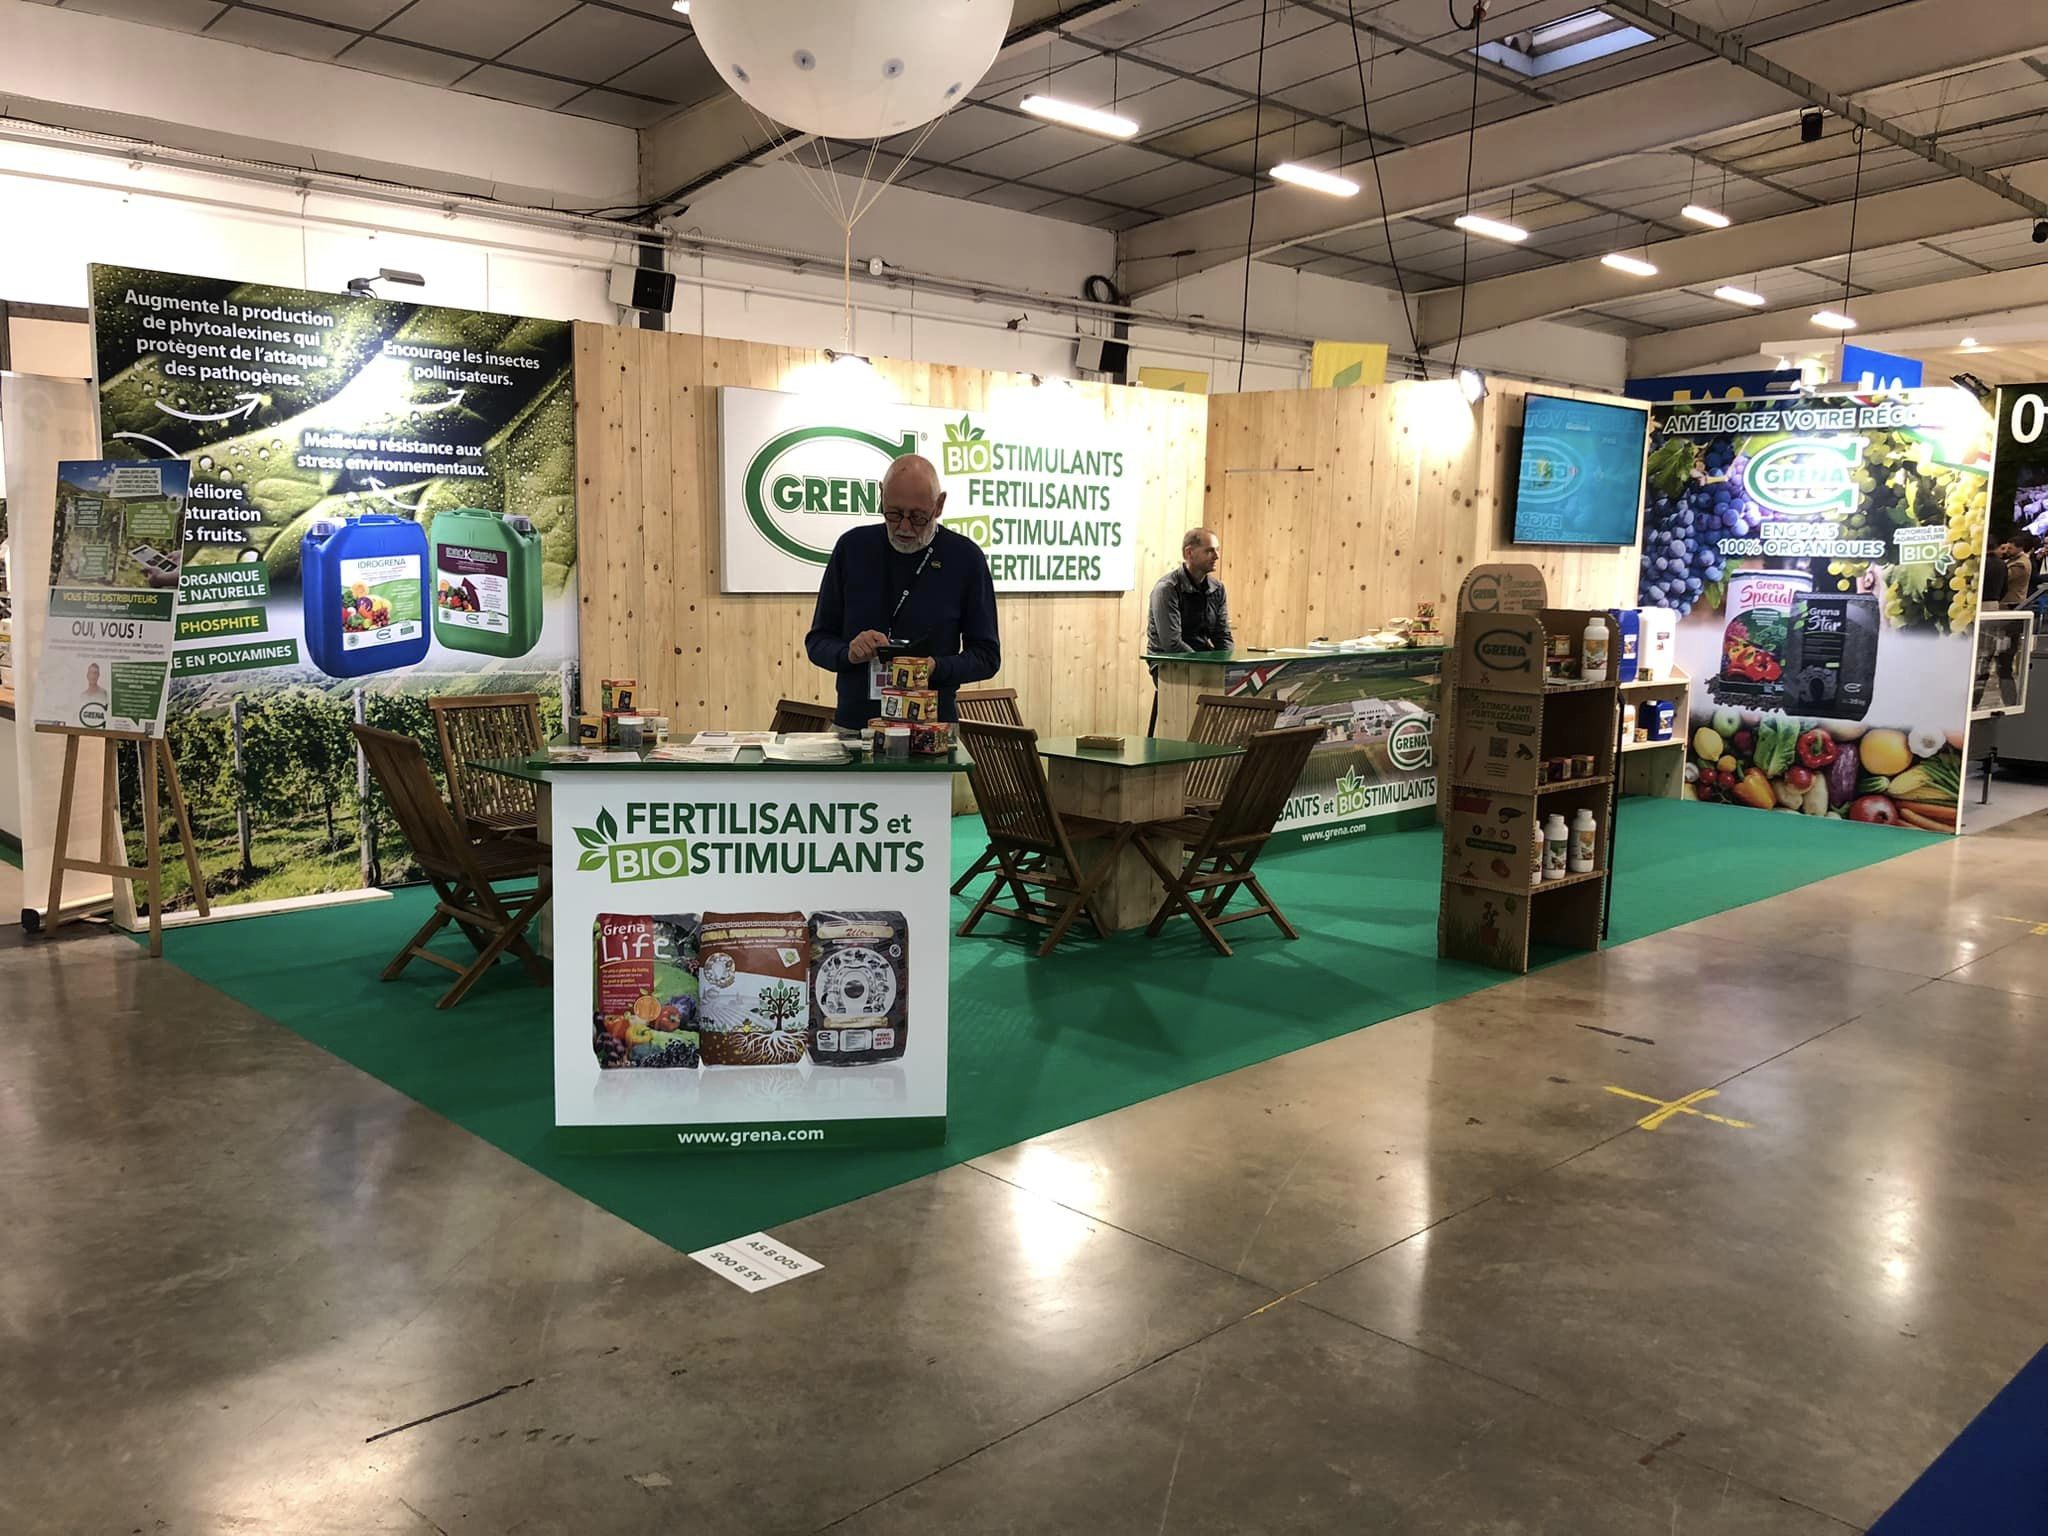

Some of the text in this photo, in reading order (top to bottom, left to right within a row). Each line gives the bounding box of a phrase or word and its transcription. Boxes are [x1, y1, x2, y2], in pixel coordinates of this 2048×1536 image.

[125, 289, 334, 327] Augmente la production
[142, 315, 320, 347] de phytoalexines qui
[136, 337, 329, 369] protègent de l'attaque
[383, 340, 540, 369] Encourage les insectes
[165, 360, 304, 386] des pathogènes.
[414, 365, 513, 386] pollinisateurs.
[1663, 411, 1779, 434] AMÉLIOREZ
[1783, 409, 1856, 430] VOTRE
[304, 432, 482, 457] Meilleure résistance aux
[298, 454, 489, 476] stress environnementaux.
[946, 443, 1123, 477] BIOSTIMULANTS
[773, 476, 883, 514] GREN
[969, 478, 1110, 511] FERTILISANTS
[197, 526, 247, 542] fruits.
[1718, 539, 1885, 557] 100% ORGANIQUES
[1904, 545, 1937, 561] BIO
[357, 557, 406, 569] IDROGRENA
[985, 554, 1101, 581] ERTILIZERS
[180, 570, 260, 586] ORGANIQUE
[1756, 580, 1784, 590] Grena
[191, 584, 266, 601] NATURELLE
[1740, 585, 1793, 607] Special
[1808, 607, 1840, 616] Grena
[72, 620, 96, 639] OUI,
[100, 622, 135, 639] VOUS
[181, 615, 260, 633] PHOSPHITE
[1808, 615, 1842, 632] Star
[186, 654, 205, 667] EN
[209, 645, 292, 664] POLYAMINES
[1396, 735, 1427, 750] GRENA
[1323, 799, 1334, 814] et
[1338, 778, 1435, 815] BIOSTIMULANTS
[626, 802, 912, 834] FERTILISANTS et
[1302, 823, 1366, 842] www.grena.com
[614, 841, 924, 879] BIOSTIMULANTS
[604, 923, 645, 935] Grena
[602, 934, 672, 962] Life
[677, 1129, 824, 1146] www.grena.com
[763, 1248, 777, 1257] B
